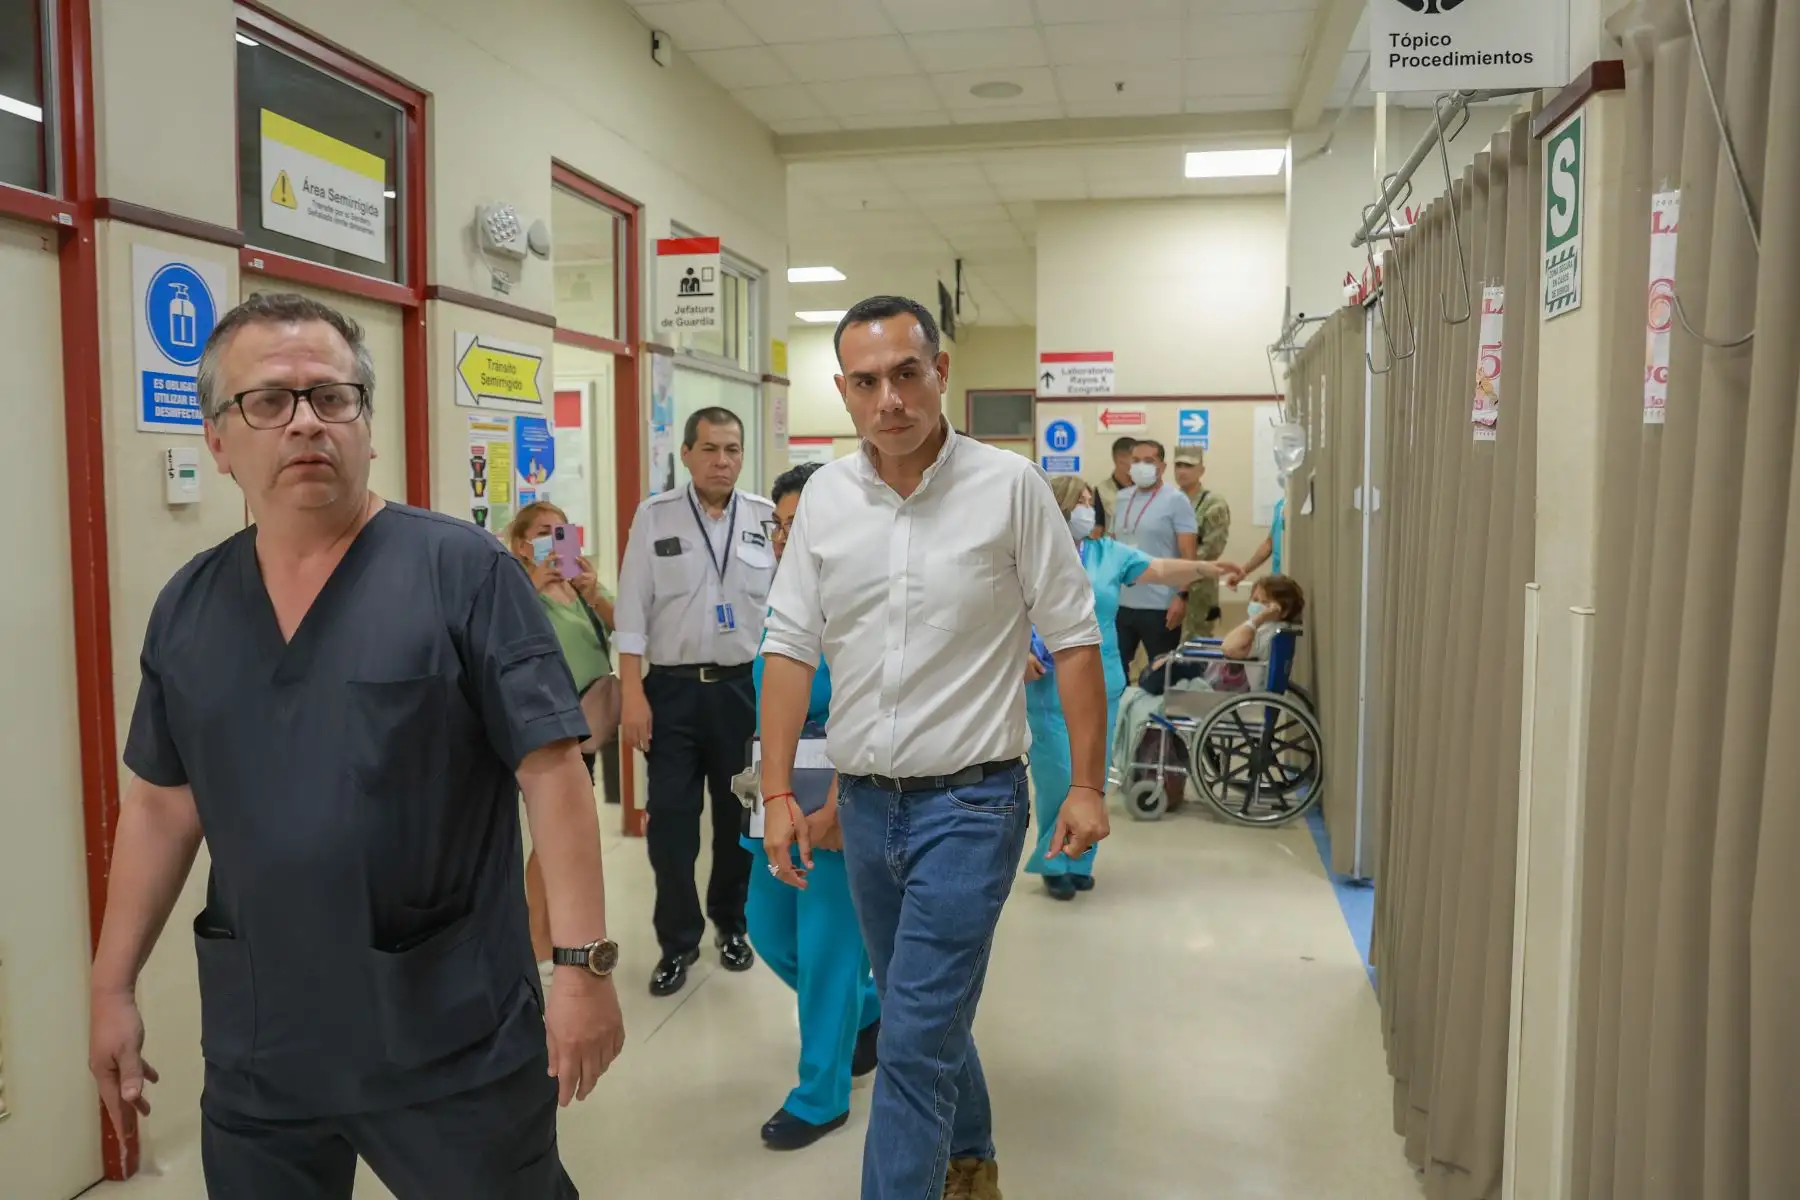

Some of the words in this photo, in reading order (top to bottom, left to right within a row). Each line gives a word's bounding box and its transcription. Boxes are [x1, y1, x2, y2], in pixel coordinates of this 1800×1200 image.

[1389, 32, 1452, 51] Tópico
[1389, 50, 1534, 68] Procedimientos
[302, 176, 326, 198] Área
[1551, 137, 1576, 238] S
[661, 317, 673, 327] de
[675, 316, 715, 327] Guardia
